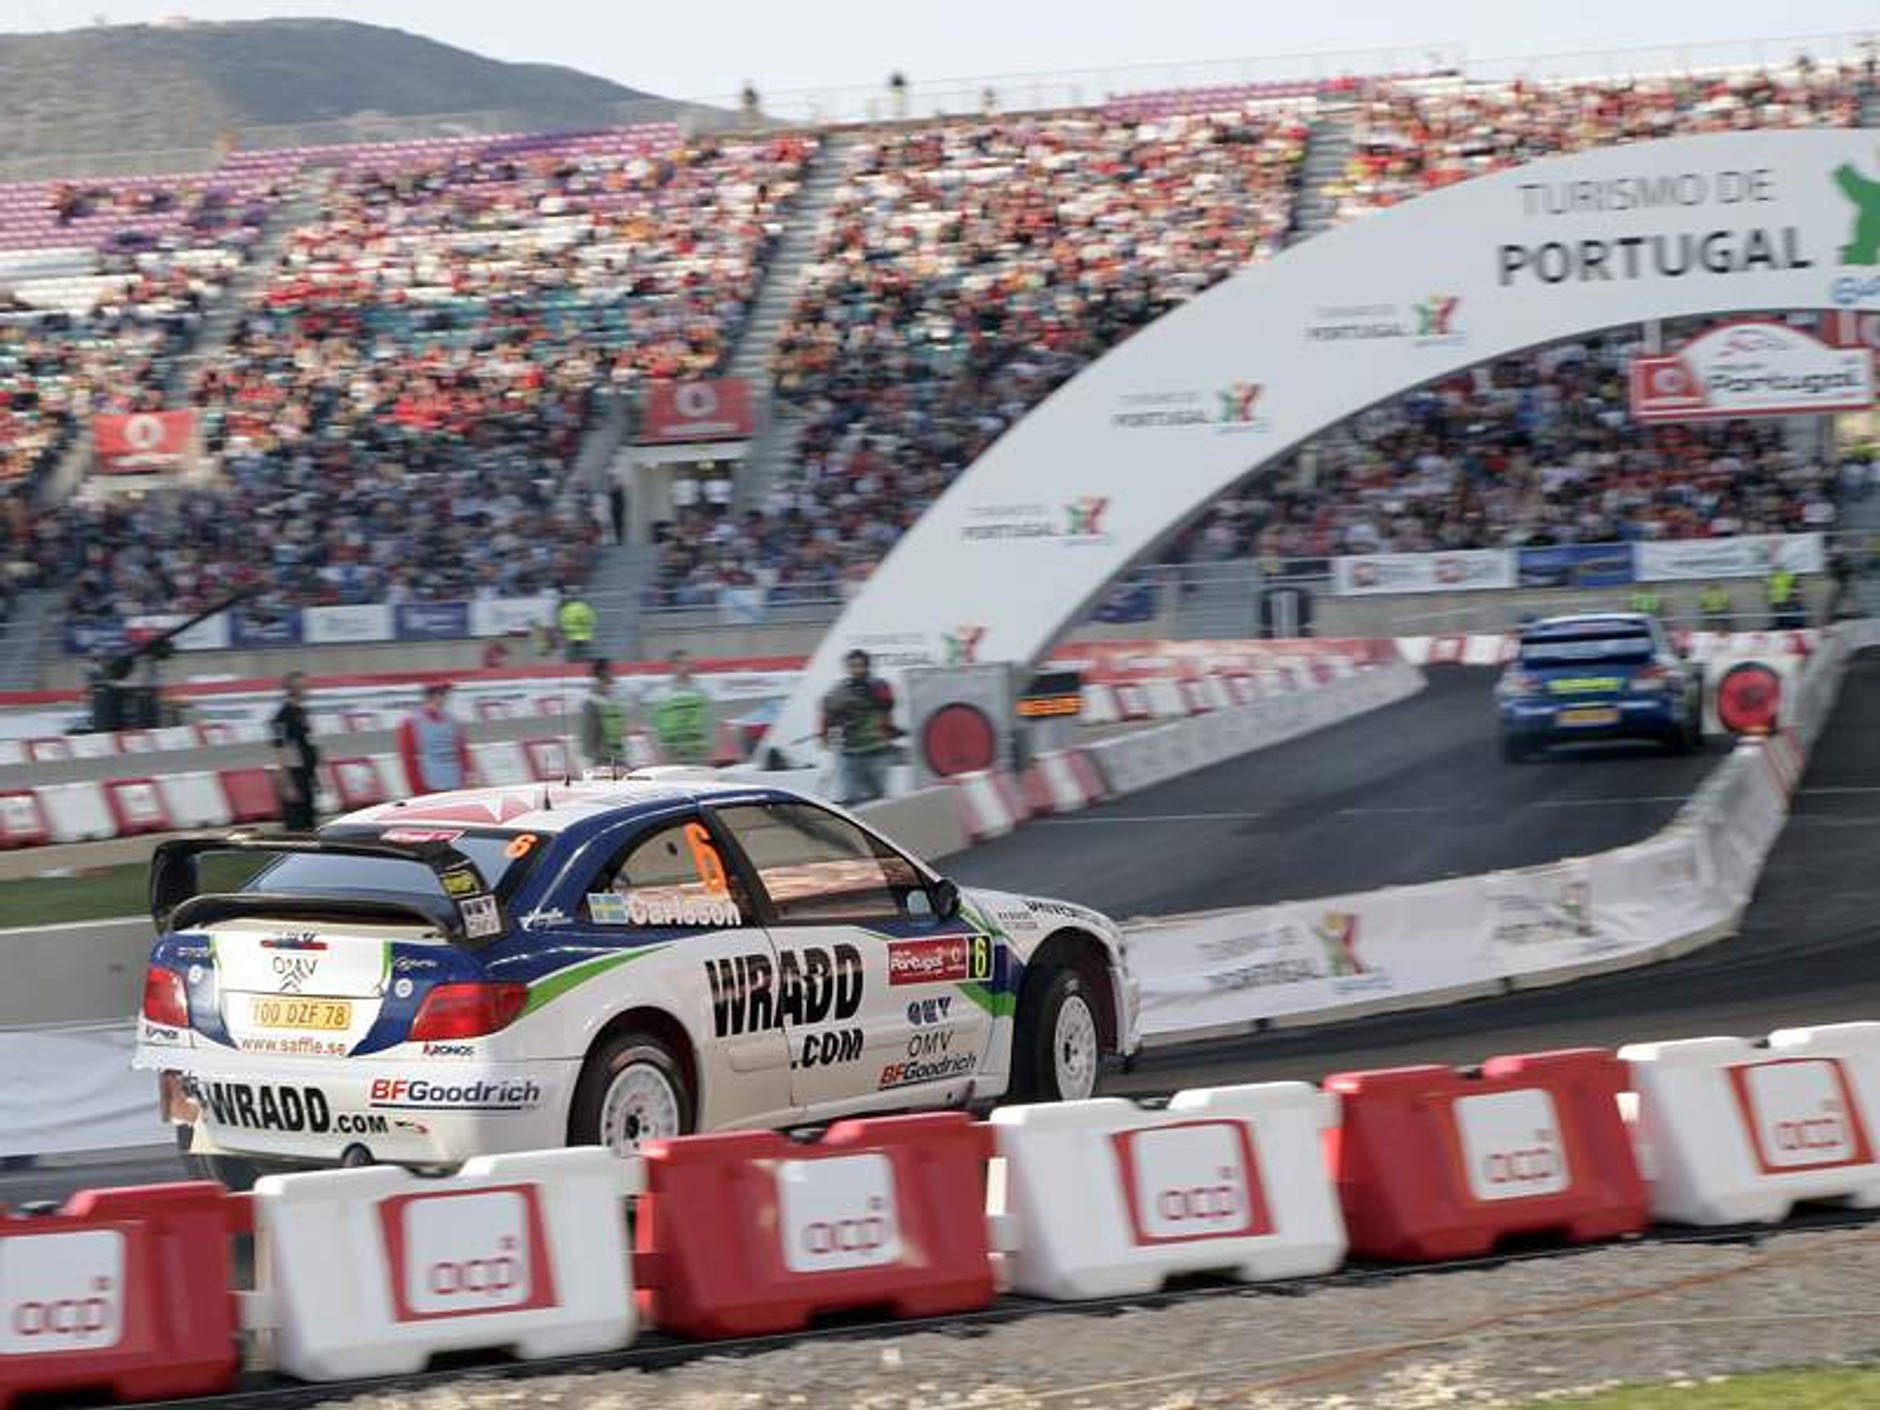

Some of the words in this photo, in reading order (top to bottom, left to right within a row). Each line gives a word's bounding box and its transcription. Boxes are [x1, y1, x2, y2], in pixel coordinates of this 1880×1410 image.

[1517, 173, 1708, 216] TURISMO
[1717, 167, 1775, 204] DE
[1497, 225, 1813, 287] PORTUGAL
[504, 832, 538, 859] 6
[684, 821, 730, 893] 6
[974, 936, 987, 979] 6
[704, 943, 864, 1038] WRADD
[286, 1002, 319, 1024] DZF
[322, 1004, 347, 1027] 78
[789, 1027, 864, 1070] .COM
[906, 1029, 955, 1058] OMV
[370, 1077, 541, 1103] BFGoodrich
[880, 1052, 978, 1086] BFGoodrich
